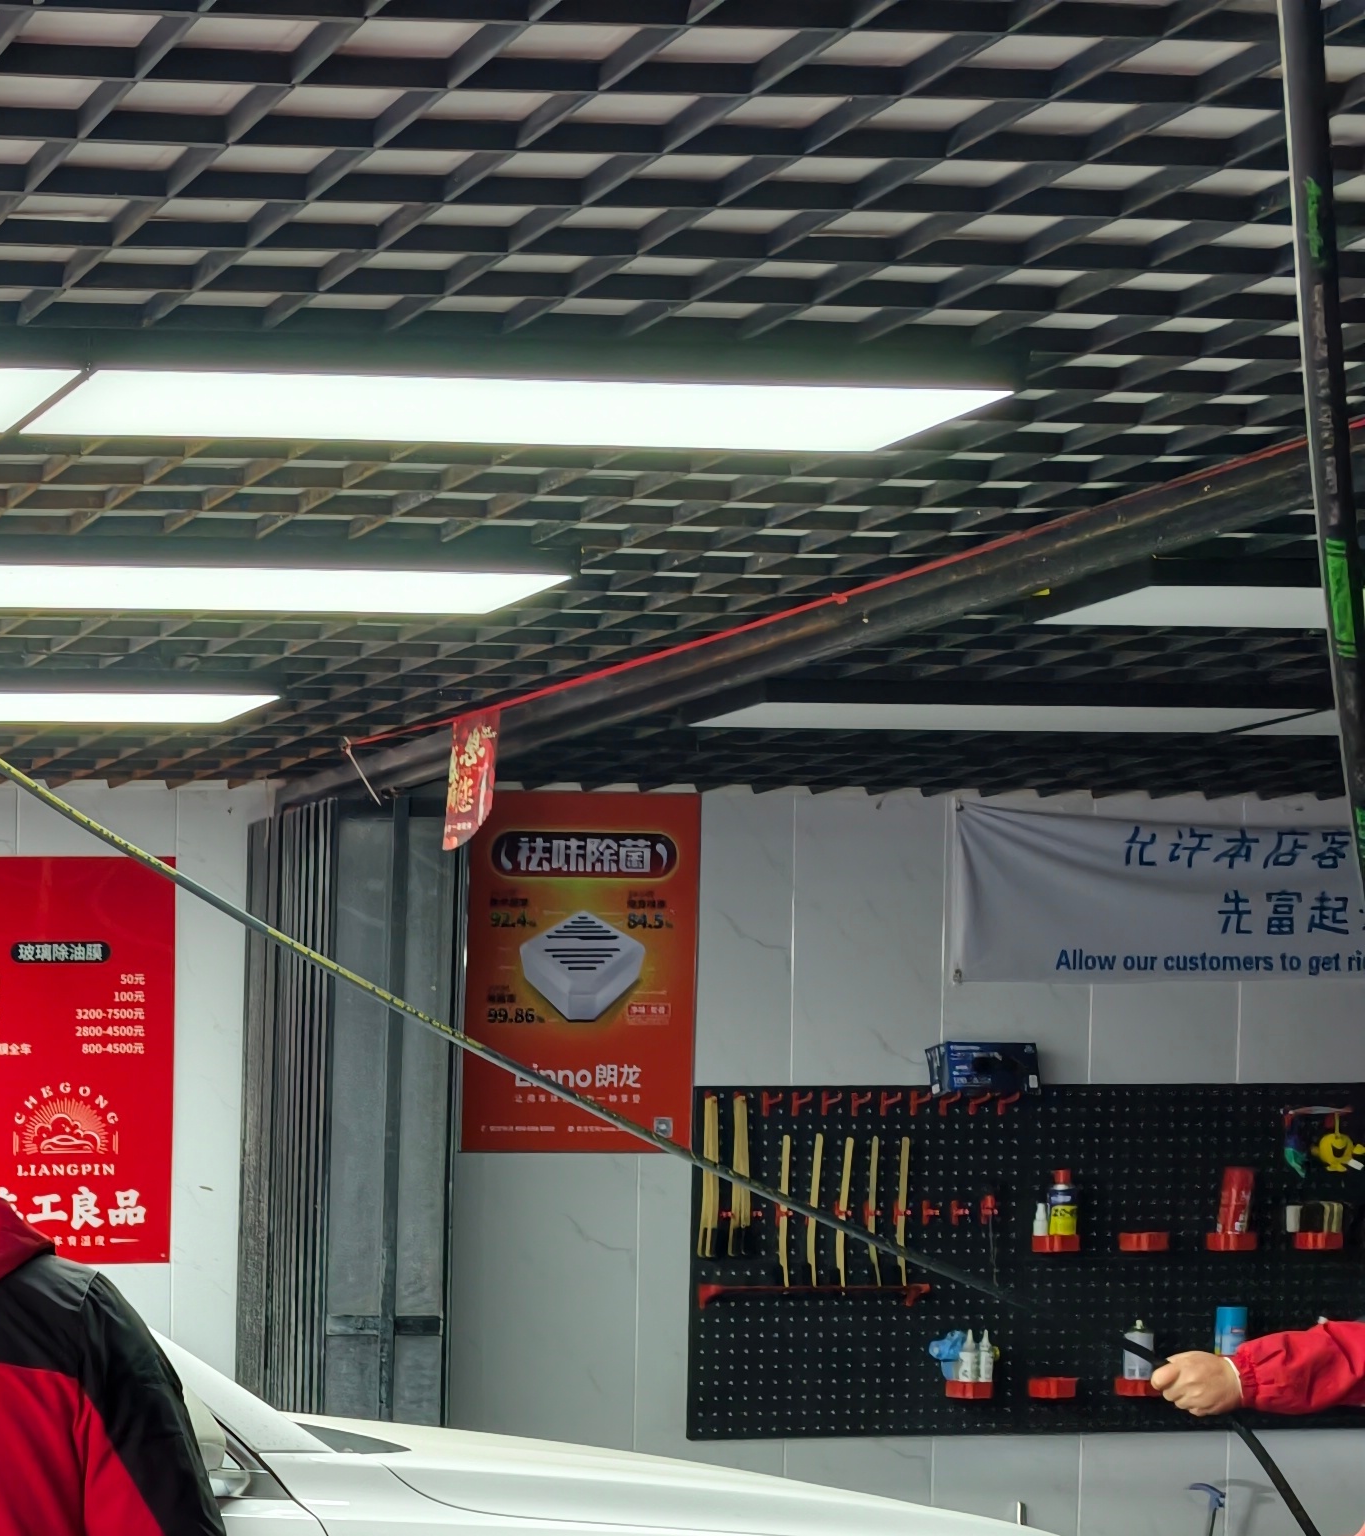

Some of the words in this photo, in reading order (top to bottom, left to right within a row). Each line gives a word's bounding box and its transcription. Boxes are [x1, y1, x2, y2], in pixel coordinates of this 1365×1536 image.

[518, 837, 651, 873] 祛味除菌
[1217, 889, 1365, 935] 先富起
[17, 943, 103, 962] 玻璃除油膜
[1056, 949, 1116, 971] Allow
[1122, 953, 1157, 971] our
[1163, 952, 1273, 972] customers
[1280, 952, 1301, 971] to
[1308, 952, 1341, 976] get
[1348, 950, 1365, 971] ri
[120, 973, 146, 986] 50元
[113, 990, 146, 1003] 100元
[75, 1008, 146, 1021] 3200-7500元
[75, 1025, 146, 1038] 2800-4500元
[81, 1042, 146, 1055] 800-4500元
[596, 1063, 642, 1088] 朗龙
[14, 1081, 119, 1125] CHEGONG
[16, 1163, 116, 1177] LIANGPIN
